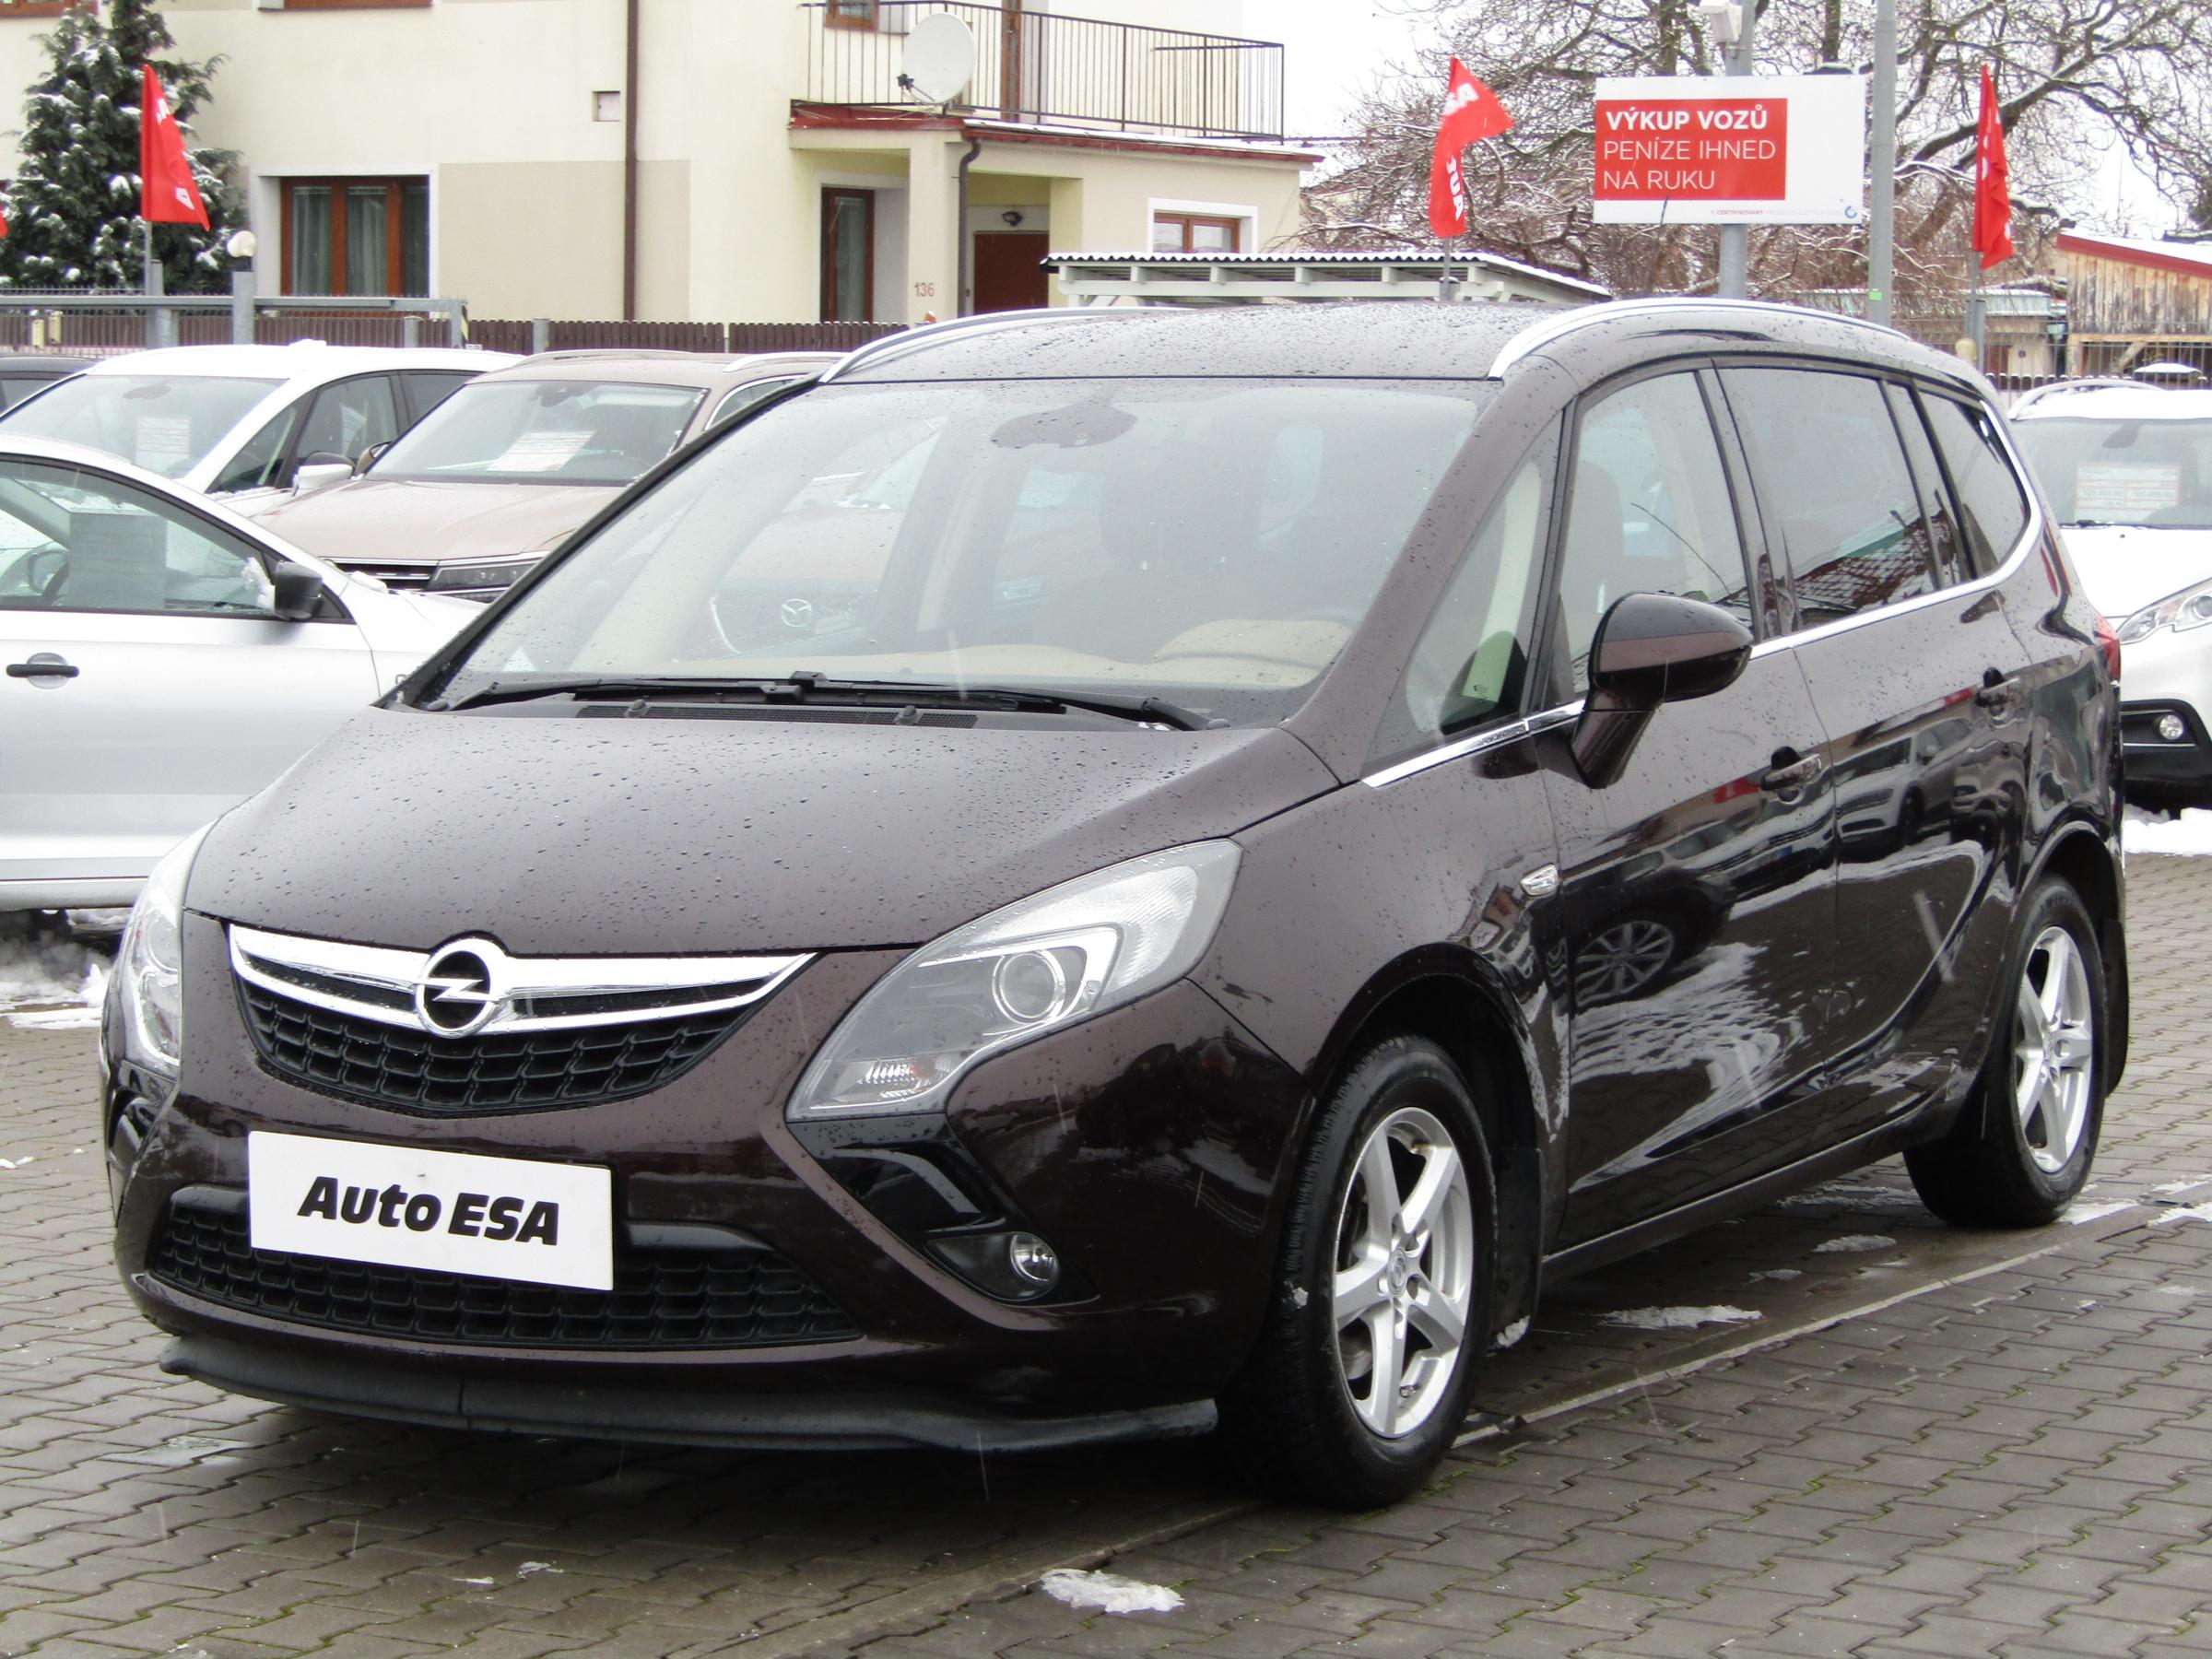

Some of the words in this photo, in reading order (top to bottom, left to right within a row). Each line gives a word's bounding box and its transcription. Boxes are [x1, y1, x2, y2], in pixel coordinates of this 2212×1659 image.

[1606, 107, 1689, 131] VÝKUP
[1697, 104, 1768, 130] VOZŮ
[1604, 136, 1690, 160] PENÍZE
[1700, 140, 1776, 159] IHNED
[1603, 171, 1638, 190] NA
[1647, 171, 1715, 190] RUKU
[914, 282, 935, 297] 136
[297, 1176, 442, 1232] Auto
[448, 1192, 559, 1246] ESA
